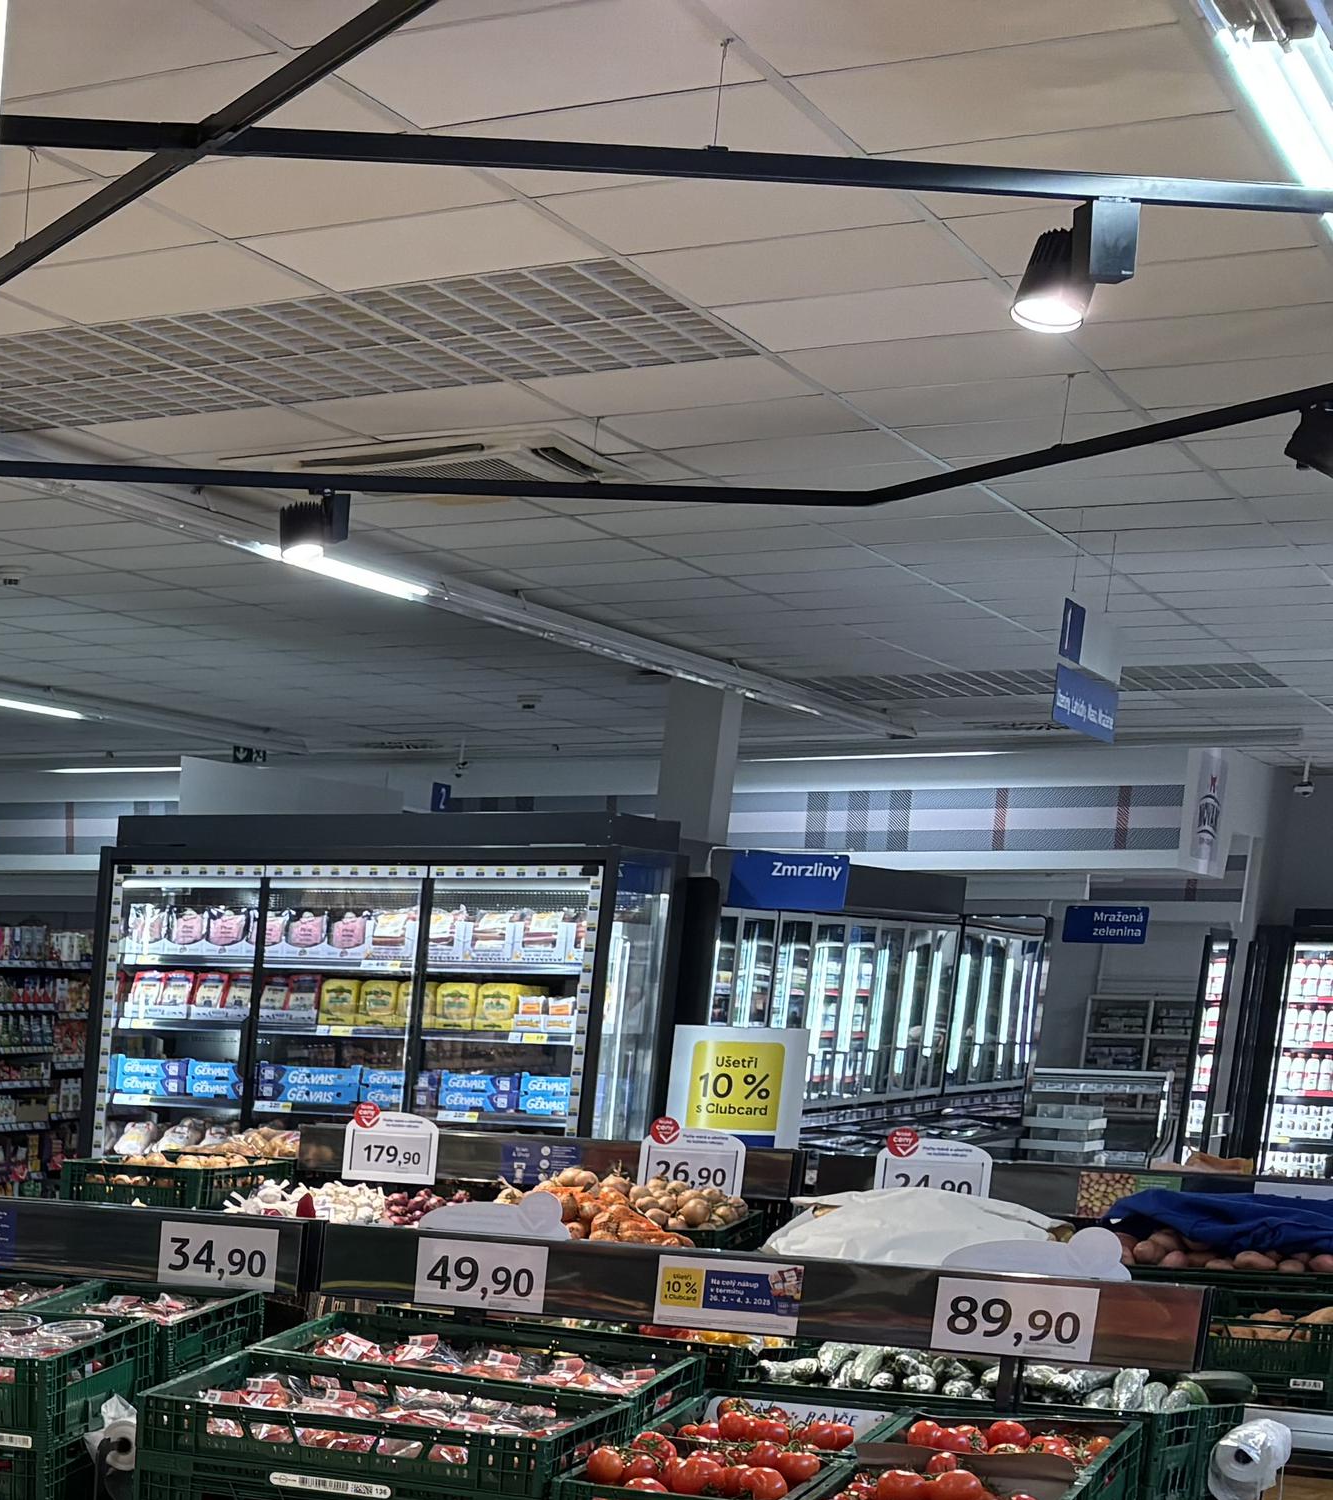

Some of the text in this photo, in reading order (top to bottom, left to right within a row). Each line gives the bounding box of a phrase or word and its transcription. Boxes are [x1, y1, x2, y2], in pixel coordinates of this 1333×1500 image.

[771, 860, 843, 882] Zmrzliny
[1093, 908, 1145, 923] Mražená
[1092, 926, 1142, 937] zelenina
[715, 1056, 759, 1069] Ušetři
[699, 1072, 770, 1100] 10 %
[696, 1102, 768, 1117] s Clubcard
[363, 1144, 421, 1167] 179,90
[655, 1159, 727, 1188] 26,90
[168, 1236, 268, 1281] 34,90
[426, 1255, 536, 1300] 49,90
[665, 1281, 698, 1295] 10 %
[945, 1294, 1082, 1349] 89,90
